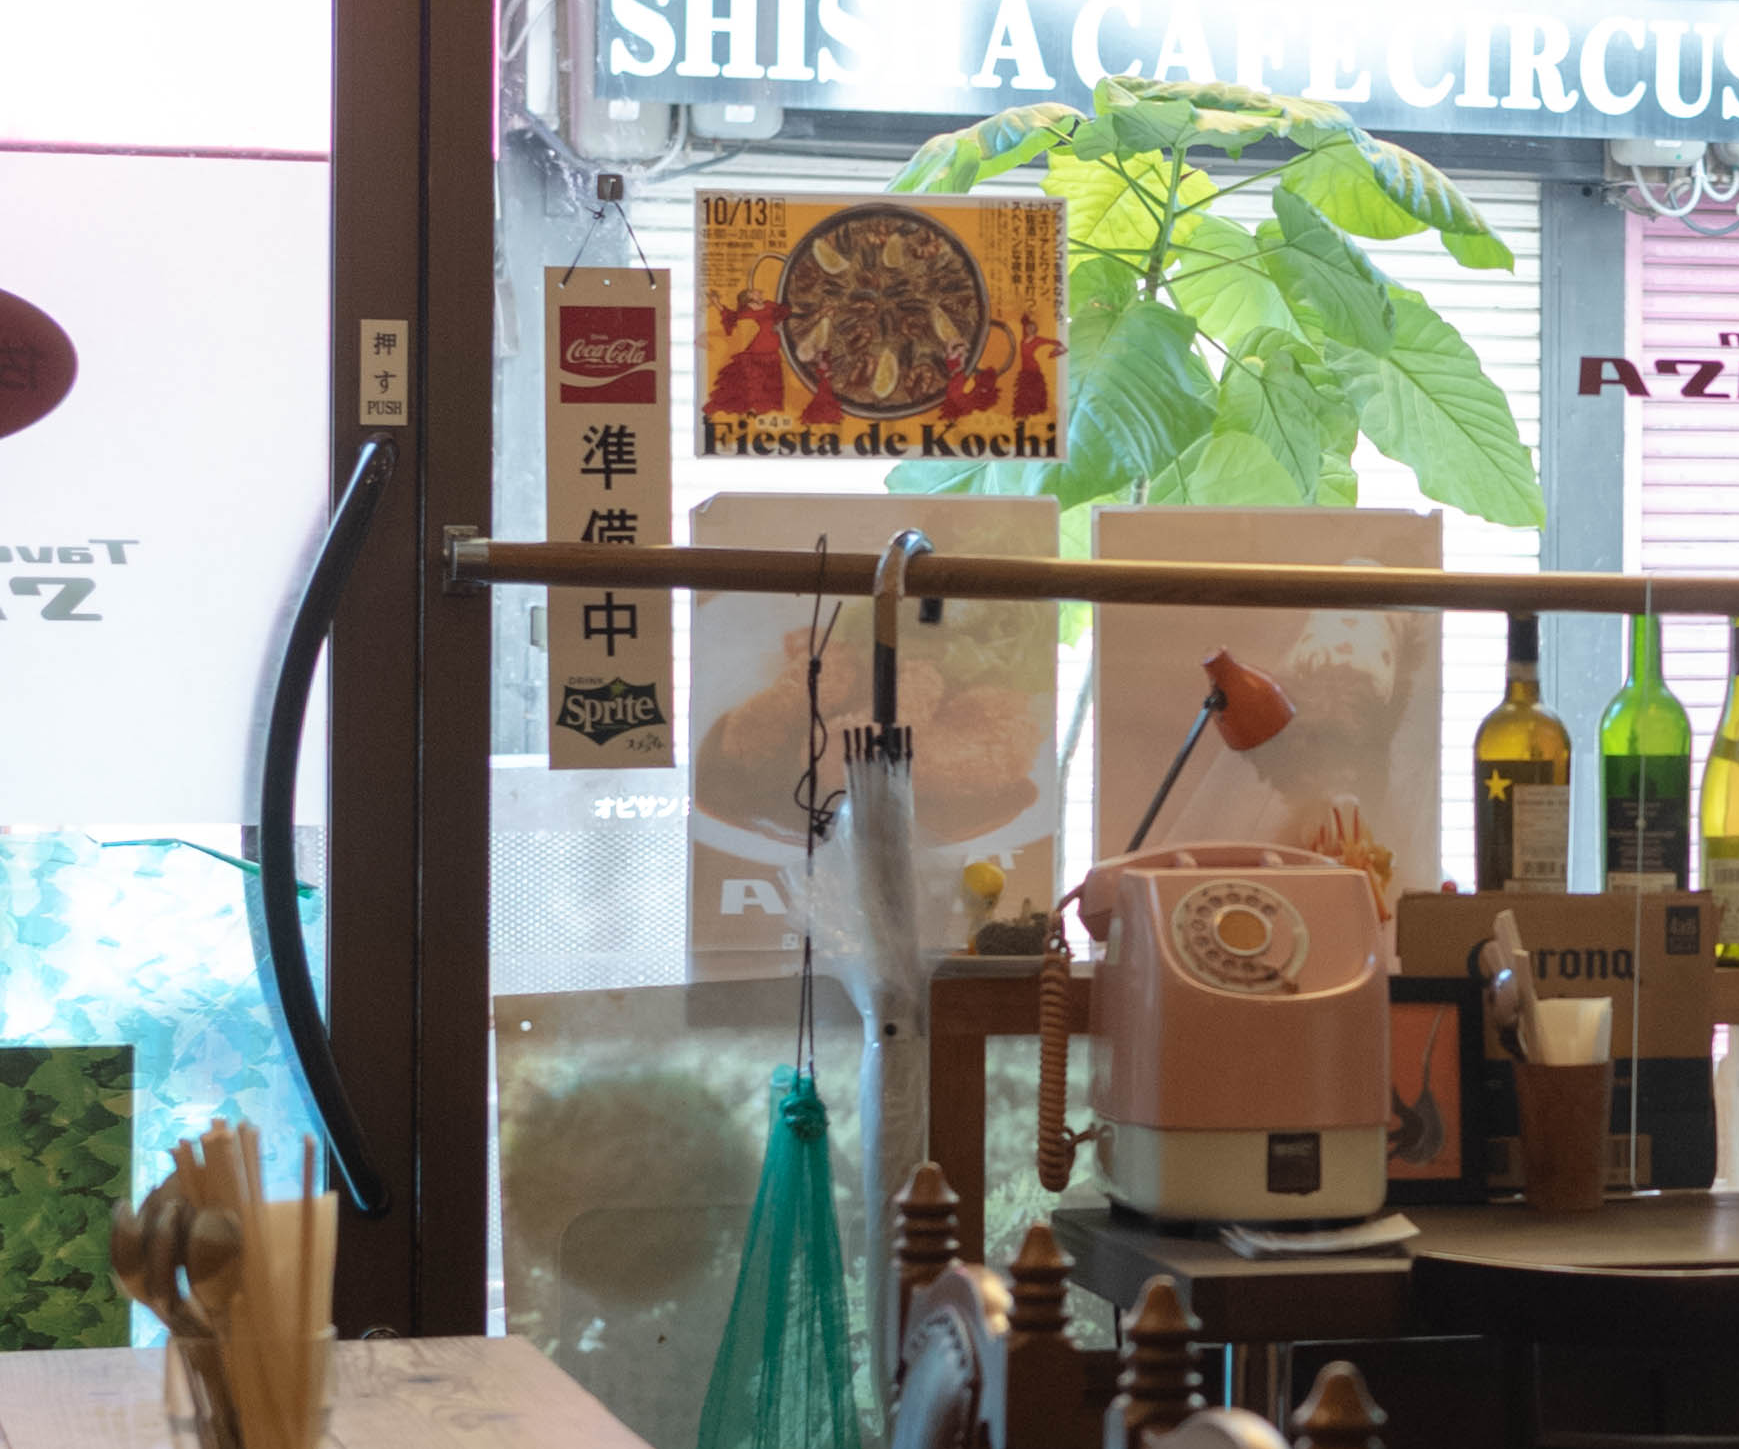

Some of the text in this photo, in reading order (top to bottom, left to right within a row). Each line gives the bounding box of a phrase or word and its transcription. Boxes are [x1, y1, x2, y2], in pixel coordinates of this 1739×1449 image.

[702, 197, 767, 226] 10/13
[373, 332, 398, 395] 押す
[367, 399, 403, 416] PUSH
[703, 413, 1059, 458] Fiesta de Kochi
[566, 693, 656, 733] Sprite
[1467, 938, 1635, 982] rona
